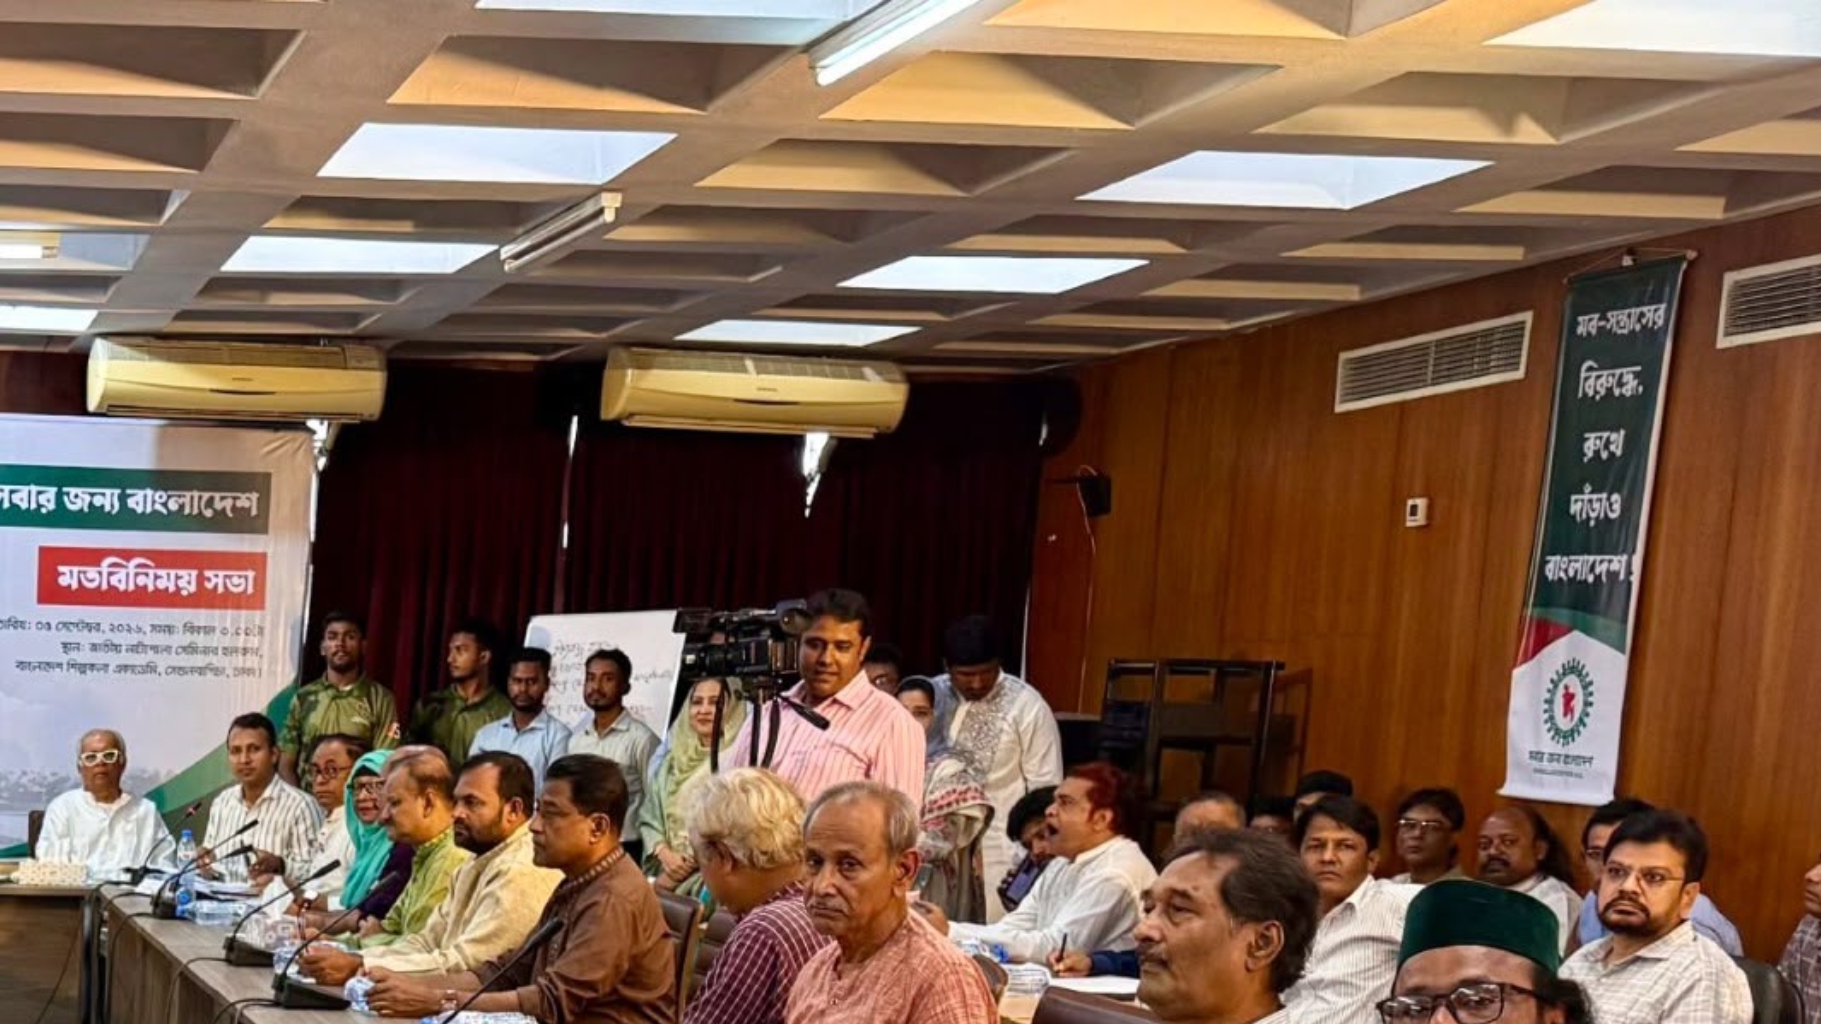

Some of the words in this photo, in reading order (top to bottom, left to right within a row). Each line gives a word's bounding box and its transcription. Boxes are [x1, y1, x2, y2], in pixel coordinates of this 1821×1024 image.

[1583, 428, 1626, 463] রুখে
[63, 486, 121, 515] জন্য
[127, 487, 260, 518] বাংলাদেশ
[1569, 482, 1621, 528] দাঁড়াও
[57, 556, 199, 596] মতবিনিময়
[204, 569, 256, 595] সভা
